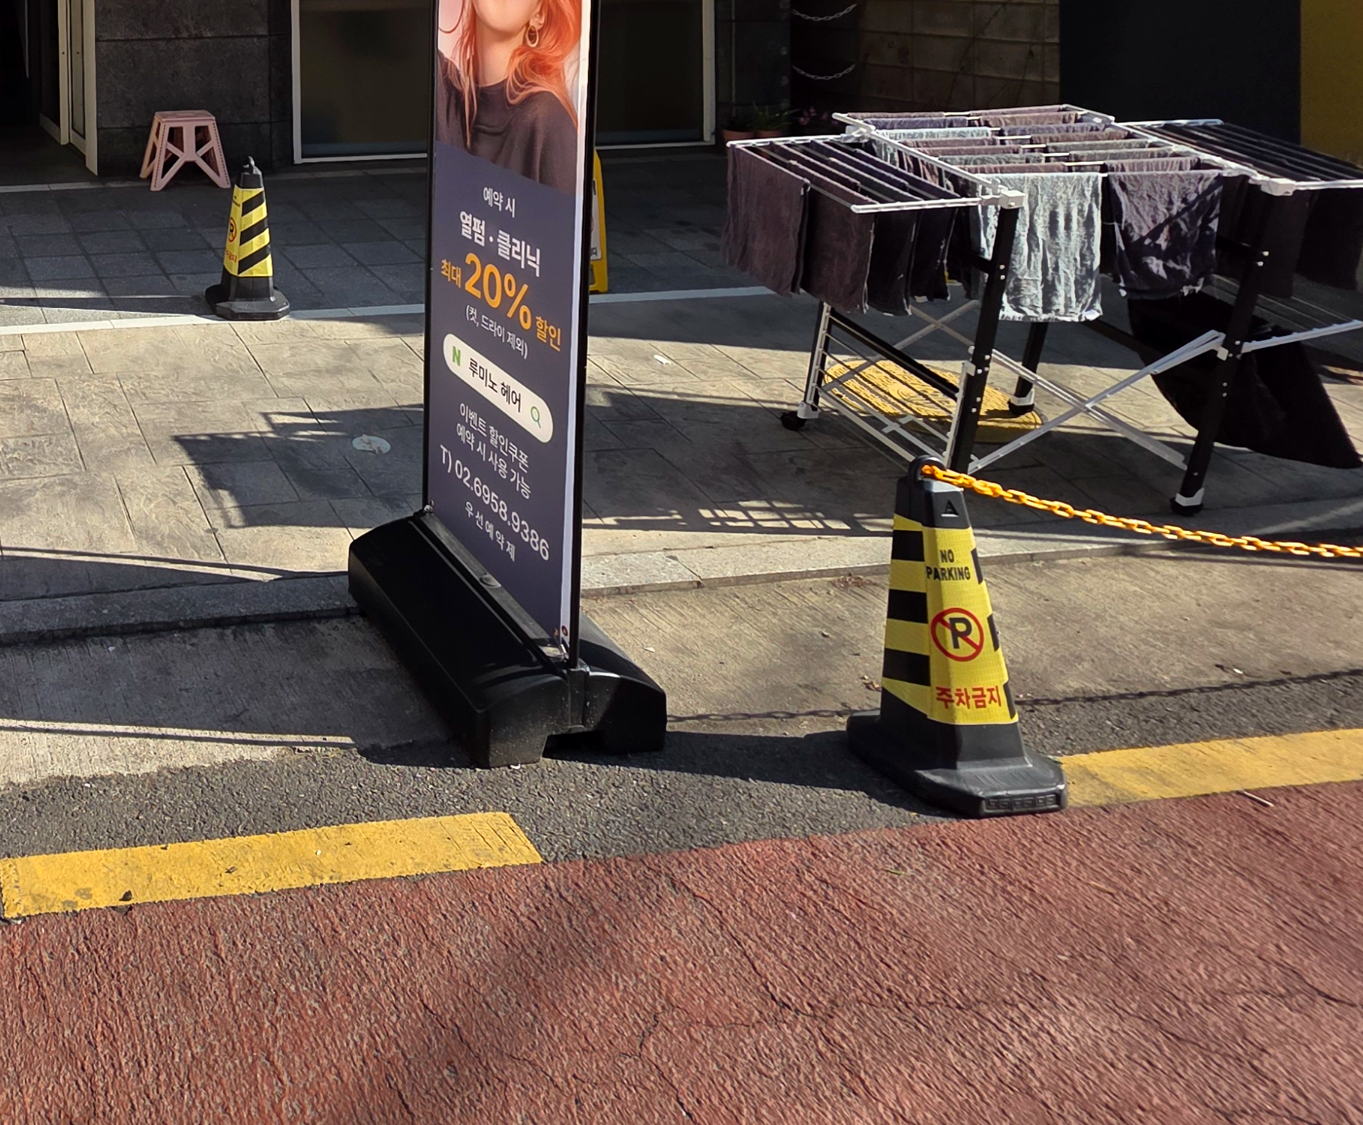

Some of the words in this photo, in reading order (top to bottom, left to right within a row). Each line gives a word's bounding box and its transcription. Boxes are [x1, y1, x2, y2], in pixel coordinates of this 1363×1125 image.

[483, 186, 503, 212] 예약
[505, 197, 516, 218] 시
[459, 210, 486, 247] 열펌
[496, 229, 541, 277] 클리닉
[440, 259, 462, 289] 최대
[464, 252, 532, 330] 20%
[535, 315, 562, 352] 할인
[452, 345, 461, 367] N
[466, 304, 479, 328] (컷,
[481, 314, 505, 343] 드라이
[507, 331, 528, 359] 제외)
[468, 357, 499, 393] 루미노
[500, 381, 522, 413] 헤어
[456, 422, 476, 451] 예약
[476, 441, 486, 461] 시
[487, 450, 509, 479] 사용
[509, 468, 532, 500] 가능
[459, 402, 487, 437] 이벤트
[488, 425, 529, 474] 할인쿠폰
[440, 444, 453, 473] T)
[454, 459, 550, 561] 02.6958.9386
[464, 501, 516, 562] 우선예약제
[940, 549, 955, 563] NO
[925, 565, 971, 581] PARKING
[935, 685, 1002, 710] 주차금지
